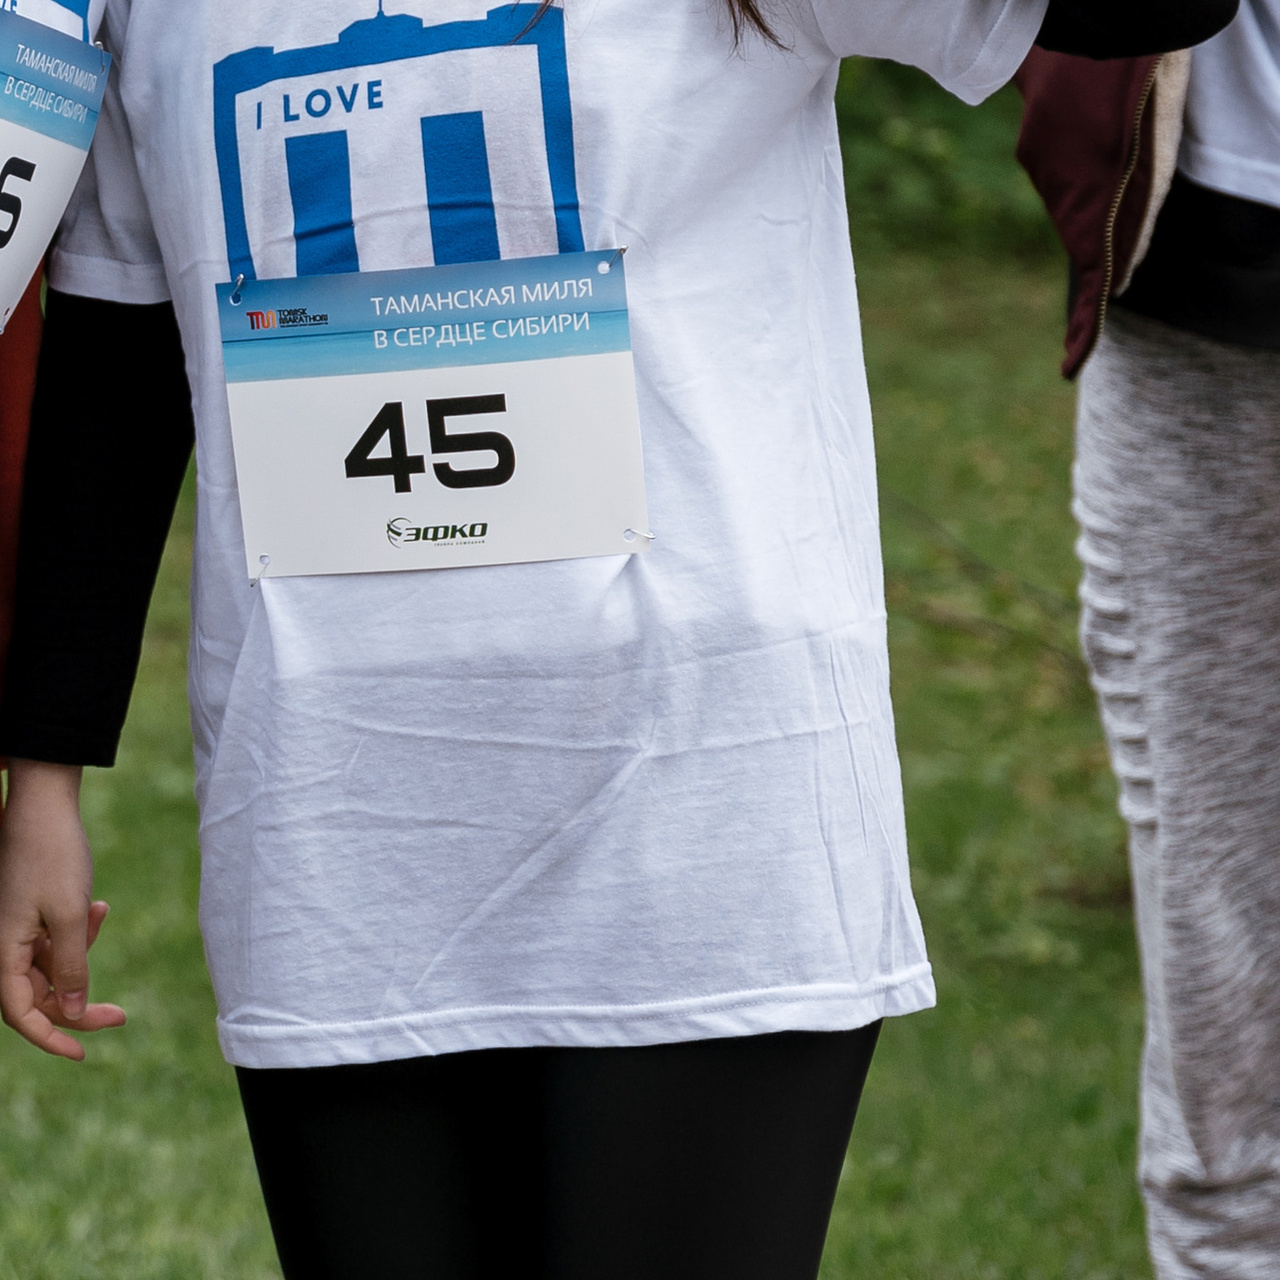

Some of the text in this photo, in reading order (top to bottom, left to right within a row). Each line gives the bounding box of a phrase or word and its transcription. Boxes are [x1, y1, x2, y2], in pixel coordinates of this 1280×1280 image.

[16, 44, 97, 94] ТАМАНСКАЯ МИЛЯ
[4, 76, 88, 124] В СЕРДЦЕ СИБИРИ
[256, 79, 385, 130] I LOVE
[370, 277, 593, 317] ТАМАНСКАЯ МИЛЯ
[373, 311, 591, 349] В СЕРДЦЕ СИБИРИ
[344, 393, 516, 493] 45
[403, 522, 488, 542] ЭФКО
